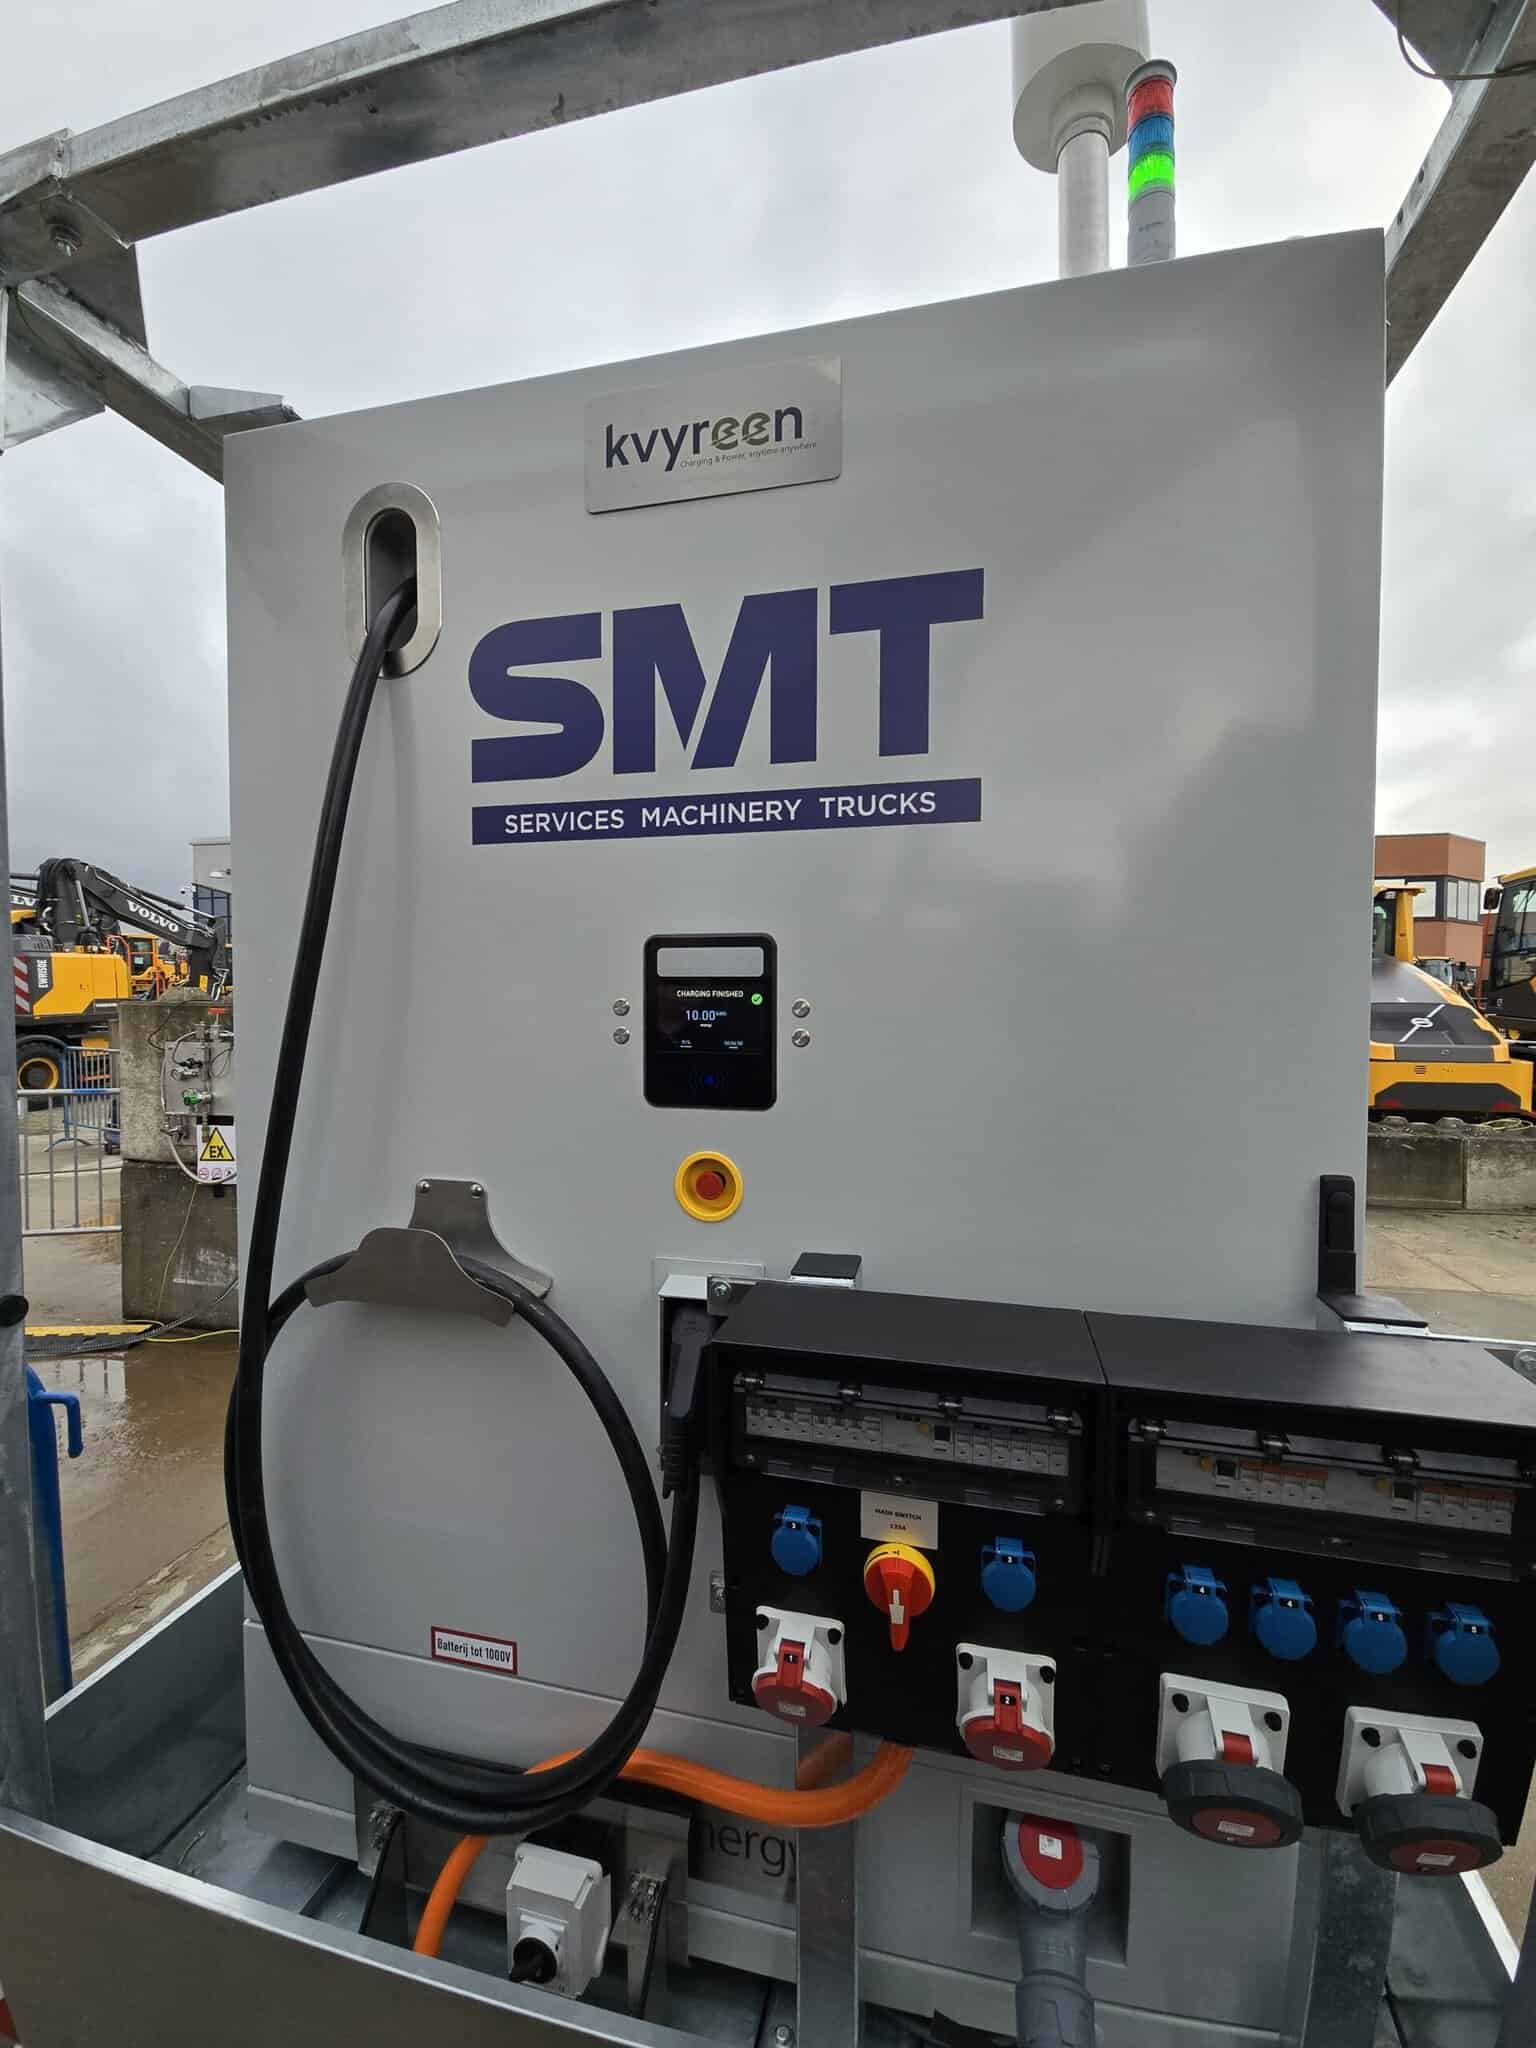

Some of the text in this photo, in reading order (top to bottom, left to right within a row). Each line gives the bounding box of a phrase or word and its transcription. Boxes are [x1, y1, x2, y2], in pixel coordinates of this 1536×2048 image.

[605, 406, 802, 471] kvyreen
[680, 457, 713, 468] Charging
[468, 567, 985, 784] SMT
[504, 791, 937, 834] SERVICES MACHINERY TRUCKS
[127, 899, 179, 932] VOLVO
[676, 989, 744, 998] CHARGING FINISHED
[685, 1009, 716, 1021] 10.00
[209, 1145, 225, 1158] EX
[895, 1510, 922, 1521] SWITCH
[437, 1638, 511, 1663] Batterij tot 1000V
[700, 1820, 797, 1879] nerg
